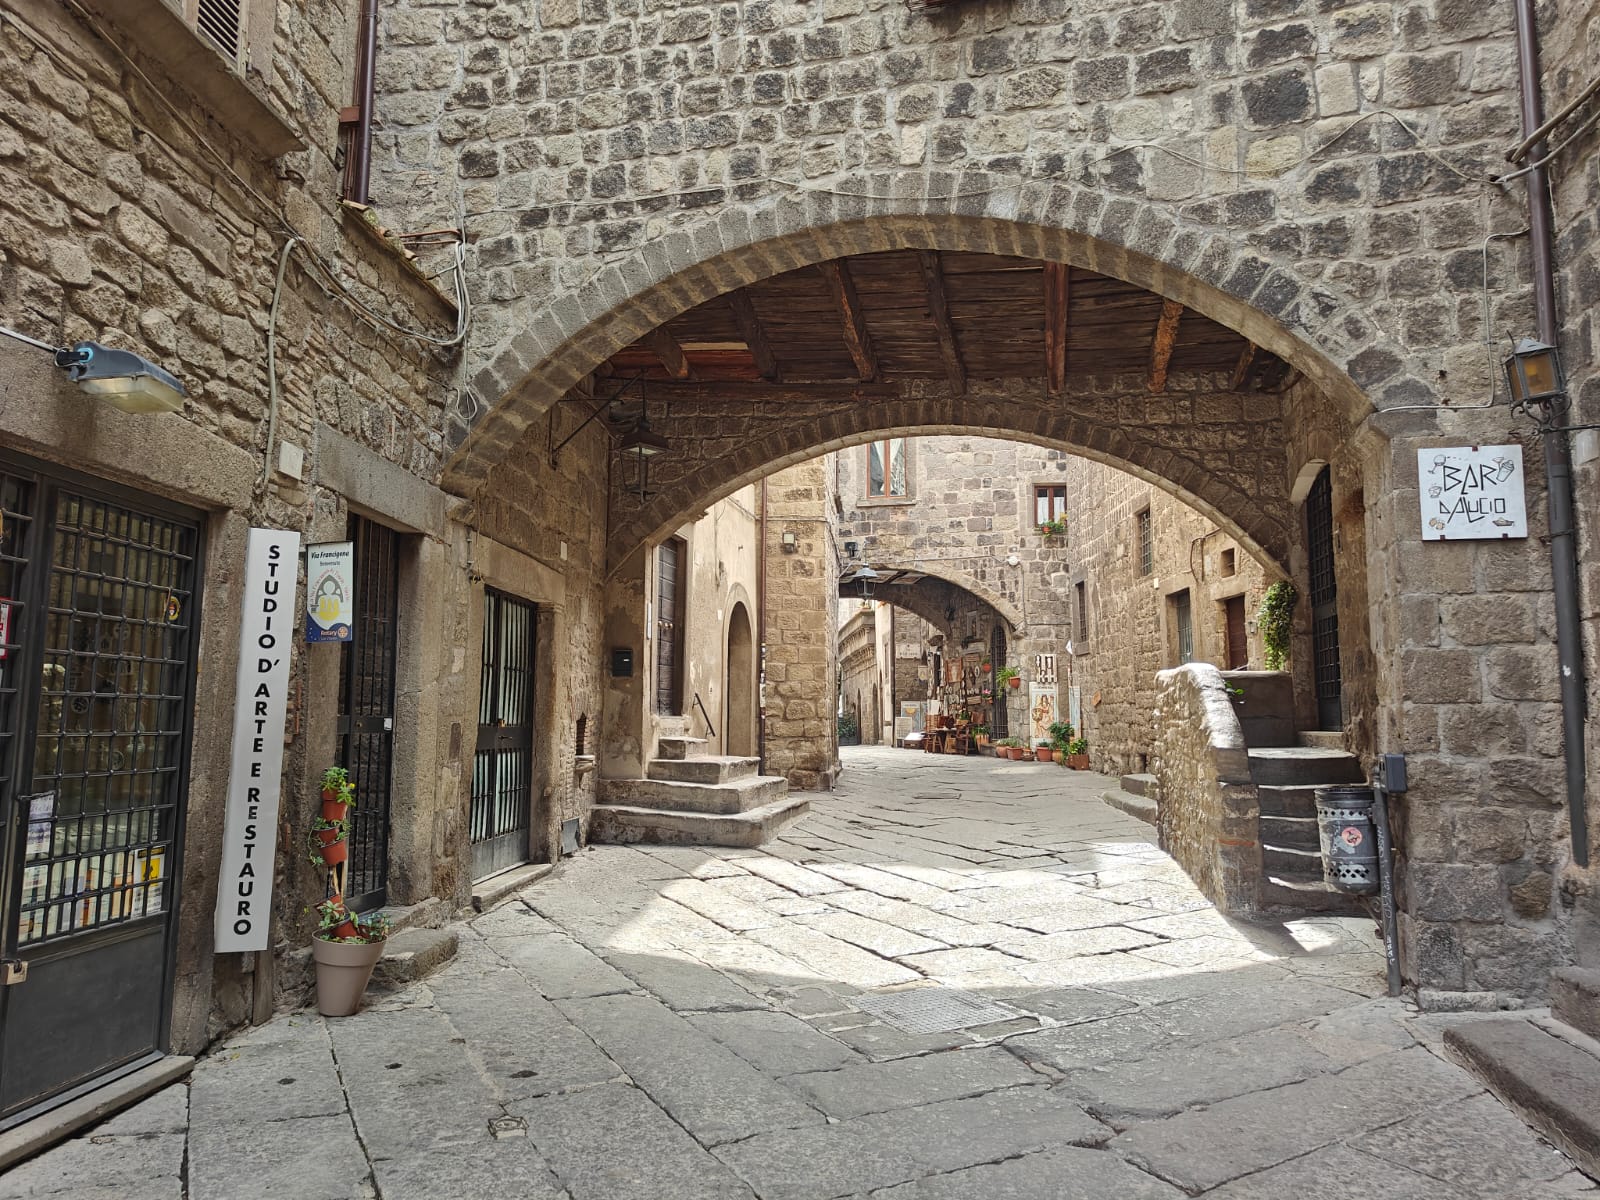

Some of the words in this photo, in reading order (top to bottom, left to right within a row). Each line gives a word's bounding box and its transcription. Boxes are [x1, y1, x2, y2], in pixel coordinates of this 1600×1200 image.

[1443, 464, 1497, 495] BAR
[259, 544, 281, 650] STUDIO
[250, 762, 262, 778] E
[234, 787, 260, 936] RESTAURO
